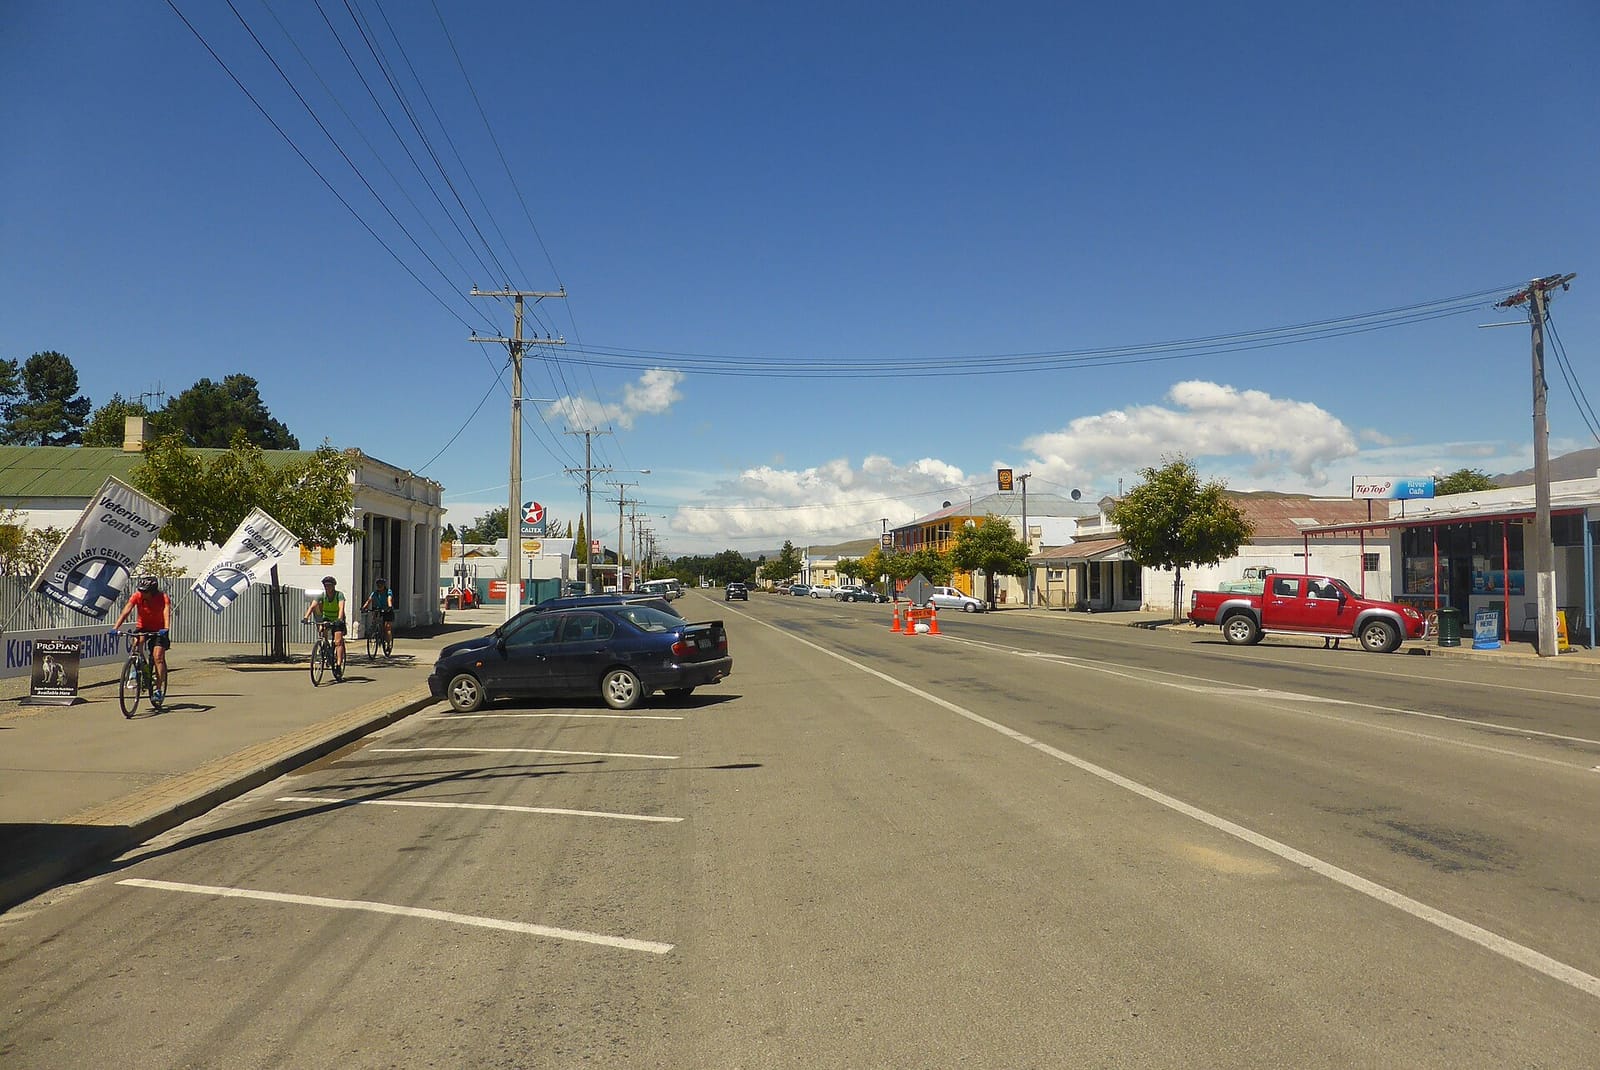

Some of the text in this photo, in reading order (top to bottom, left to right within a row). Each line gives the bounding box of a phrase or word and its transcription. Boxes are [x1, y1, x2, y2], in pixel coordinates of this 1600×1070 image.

[1407, 480, 1427, 488] River
[1408, 487, 1424, 495] Cafe
[98, 496, 160, 533] Veterinary
[100, 513, 141, 539] Centre
[241, 537, 268, 561] Centre
[243, 524, 284, 558] Veterinary
[54, 547, 136, 585] VETERINARY CENTRE
[7, 638, 32, 668] KUR
